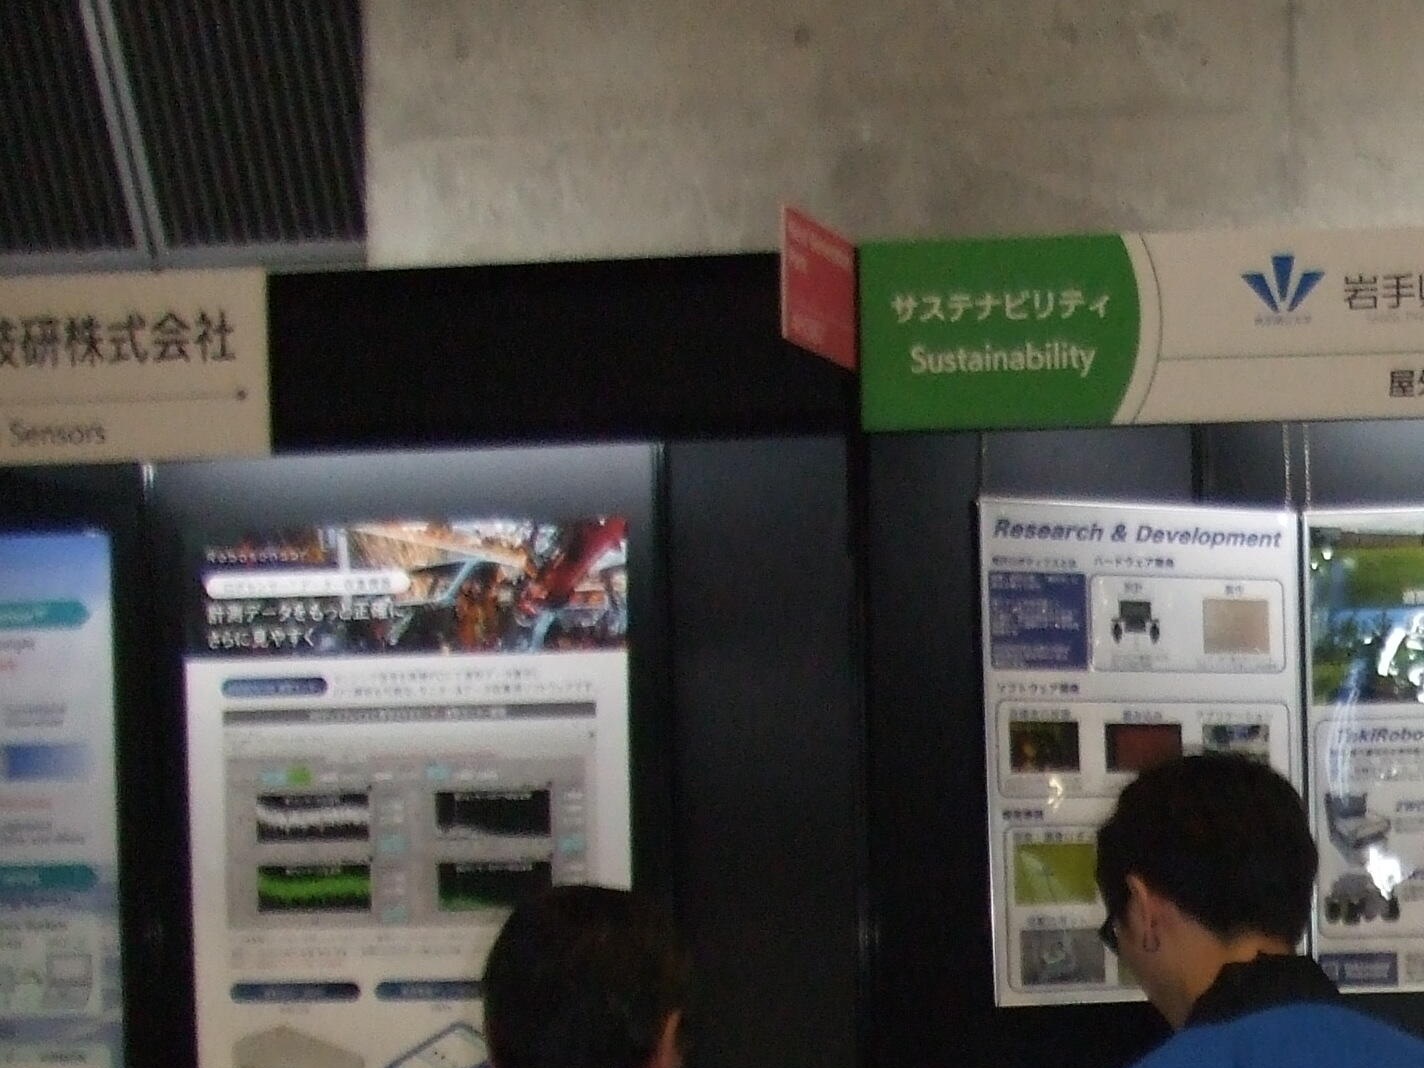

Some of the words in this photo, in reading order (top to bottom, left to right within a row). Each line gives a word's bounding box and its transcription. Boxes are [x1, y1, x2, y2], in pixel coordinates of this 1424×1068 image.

[890, 288, 1110, 323] サステナビリティ
[909, 343, 1096, 377] Sustainability
[9, 417, 106, 447] Sensors
[994, 518, 1104, 543] Research
[1110, 522, 1128, 543] &
[1136, 525, 1283, 548] Development
